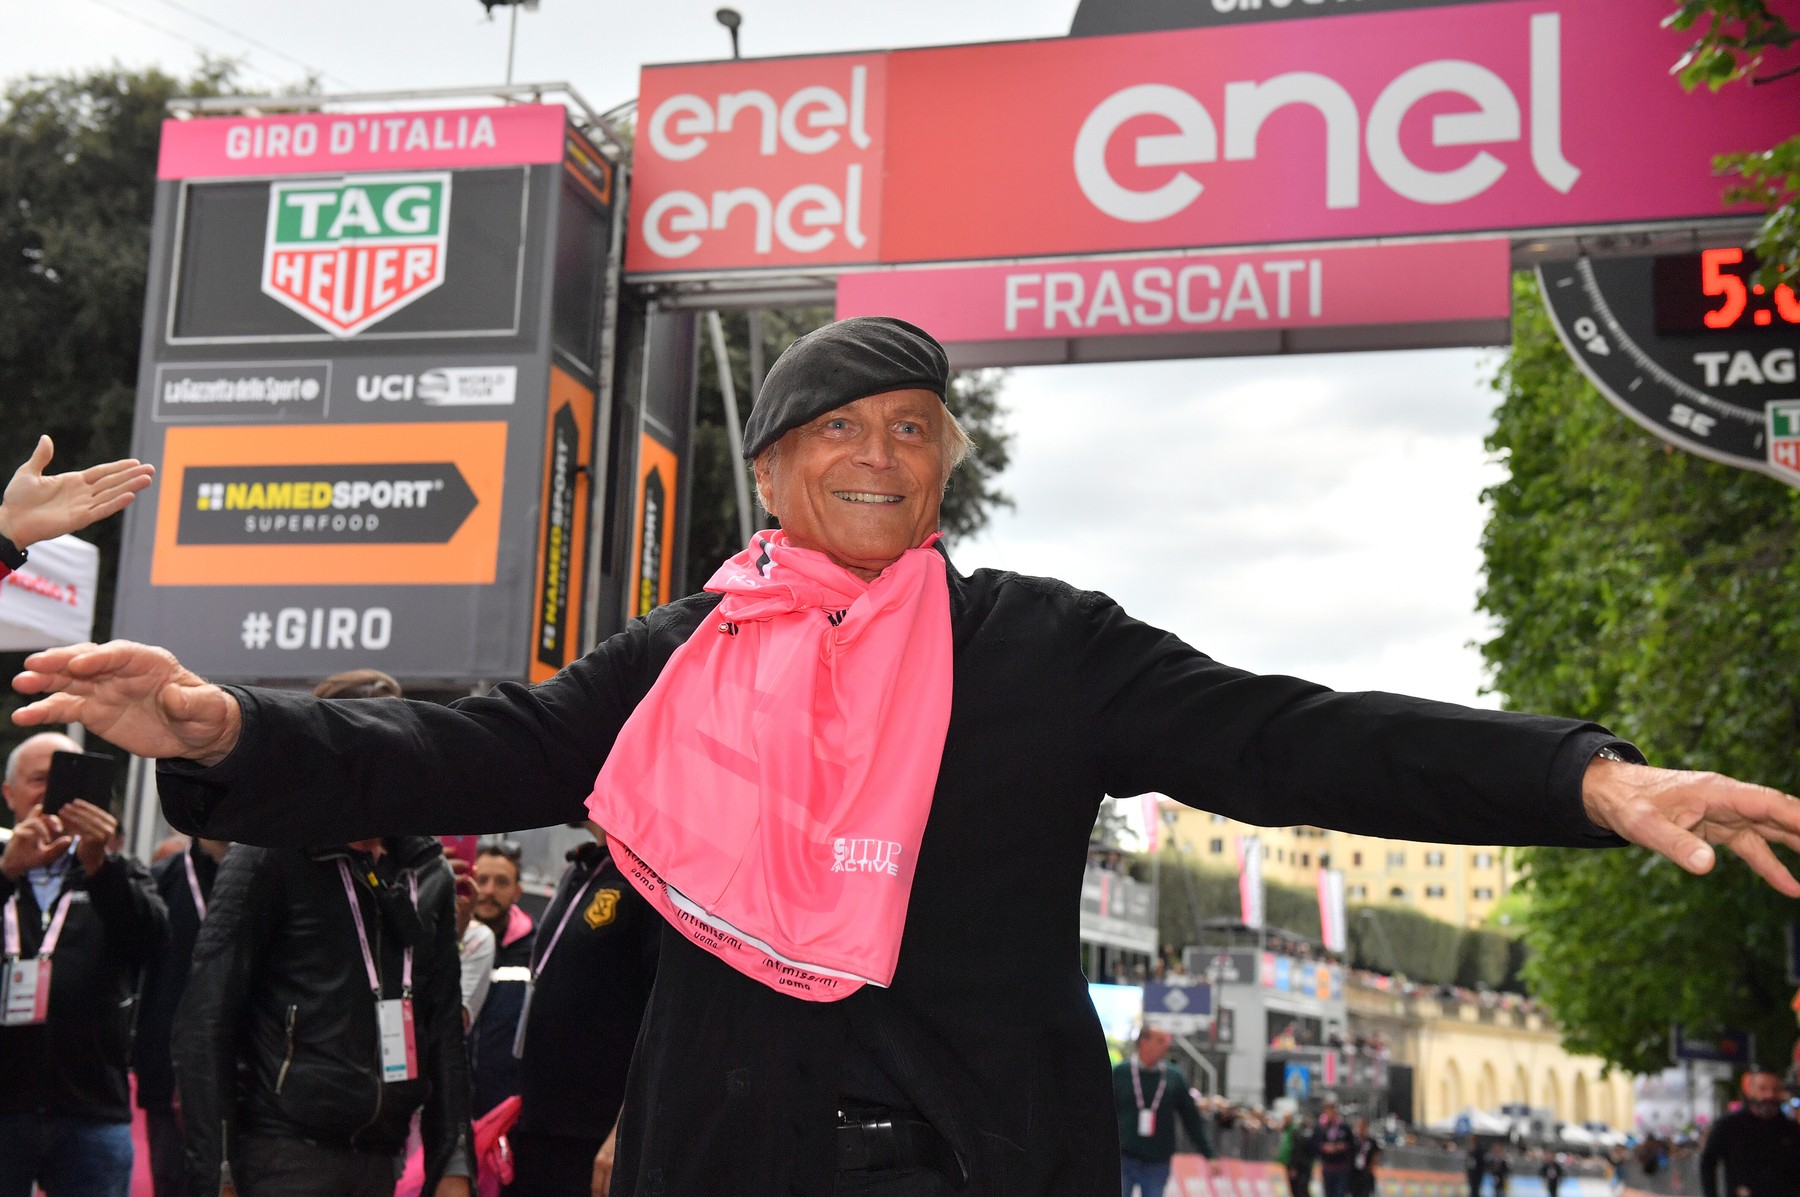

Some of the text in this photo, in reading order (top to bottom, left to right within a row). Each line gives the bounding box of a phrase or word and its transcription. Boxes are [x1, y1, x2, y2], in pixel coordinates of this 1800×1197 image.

[648, 65, 872, 161] enel
[1073, 12, 1582, 222] enel
[226, 114, 497, 160] GIRO D'ITALIA
[285, 185, 433, 240] TAG
[642, 163, 867, 259] enel
[275, 247, 434, 325] HEUER
[1004, 258, 1323, 331] FRASCATI
[356, 374, 415, 402] UCI
[1693, 349, 1797, 388] TAG
[244, 513, 380, 533] SUPERFOOD
[240, 607, 393, 650] #GIRO
[830, 859, 900, 877] ACTIVE
[832, 837, 903, 863] SITIP
[676, 908, 743, 951] intimissimi
[762, 957, 838, 988] intimissimi
[778, 977, 811, 991] uomo
